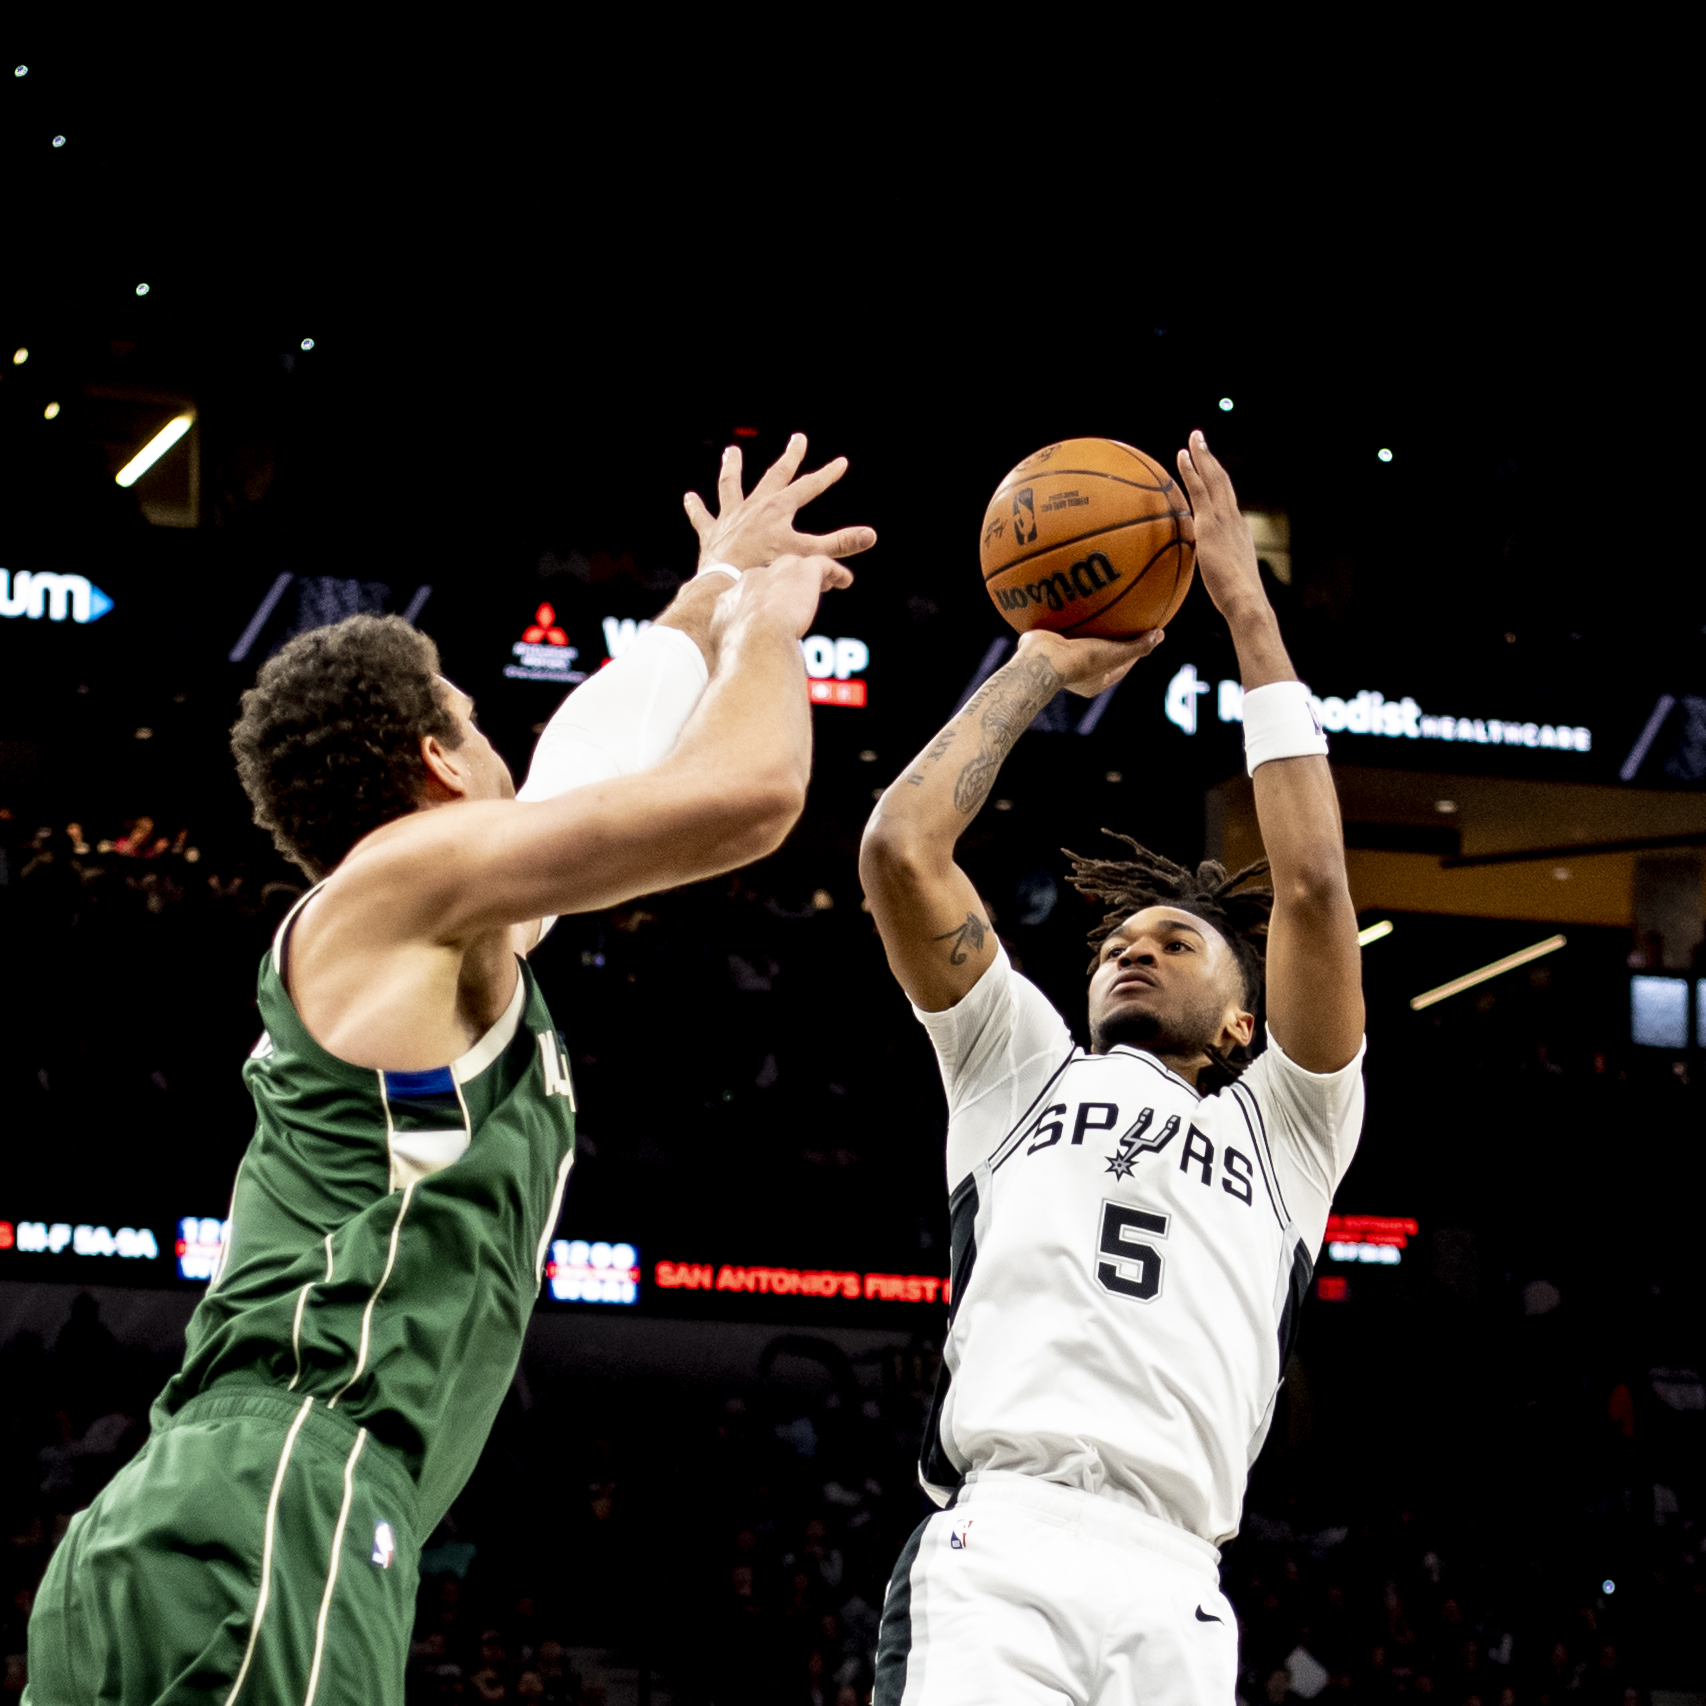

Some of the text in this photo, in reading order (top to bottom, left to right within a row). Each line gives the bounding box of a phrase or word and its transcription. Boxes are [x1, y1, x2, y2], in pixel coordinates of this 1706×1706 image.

[995, 550, 1123, 611] Wilson
[1420, 713, 1592, 752] HEALTHCARE
[1026, 1101, 1254, 1207] SPURS
[655, 1259, 713, 1290] SAN
[715, 1263, 862, 1300] ANTONIO'S
[864, 1272, 943, 1304] FIRST
[1094, 1197, 1172, 1305] 5
